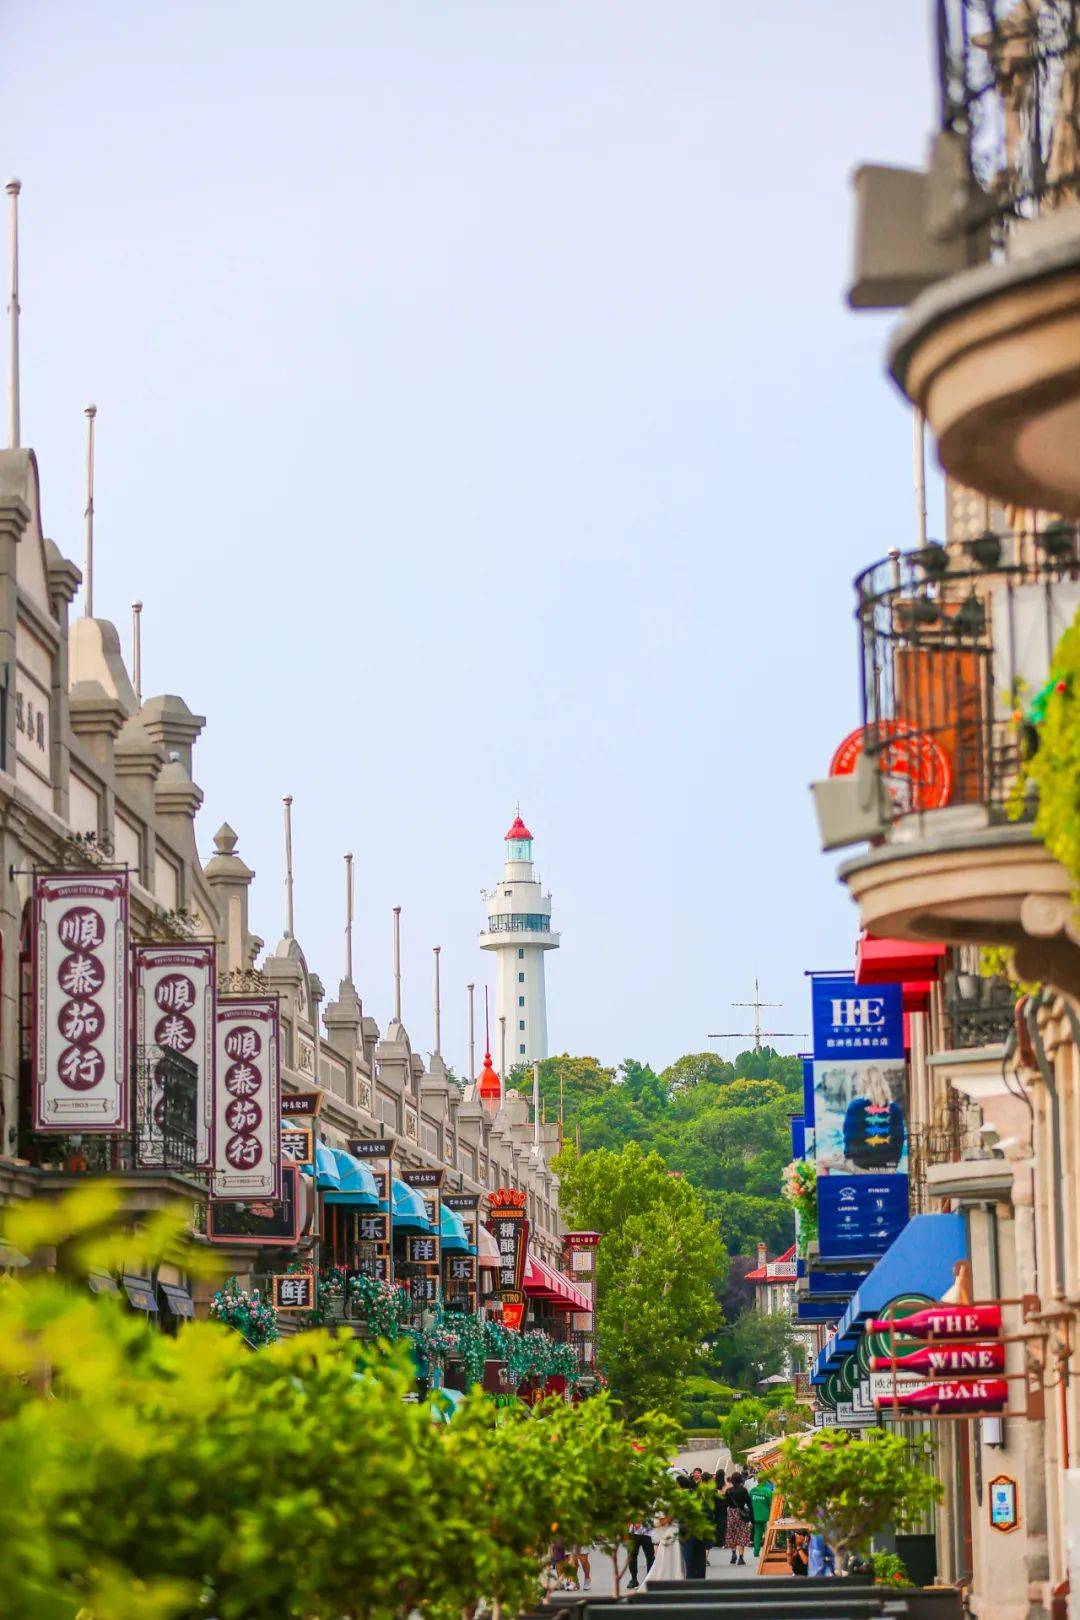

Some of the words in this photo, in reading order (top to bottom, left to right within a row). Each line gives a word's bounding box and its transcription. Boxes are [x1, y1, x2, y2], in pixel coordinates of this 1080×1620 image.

[500, 1222, 515, 1286] 精酿啤酒
[928, 1314, 980, 1333] THE
[928, 1351, 995, 1370] WINE
